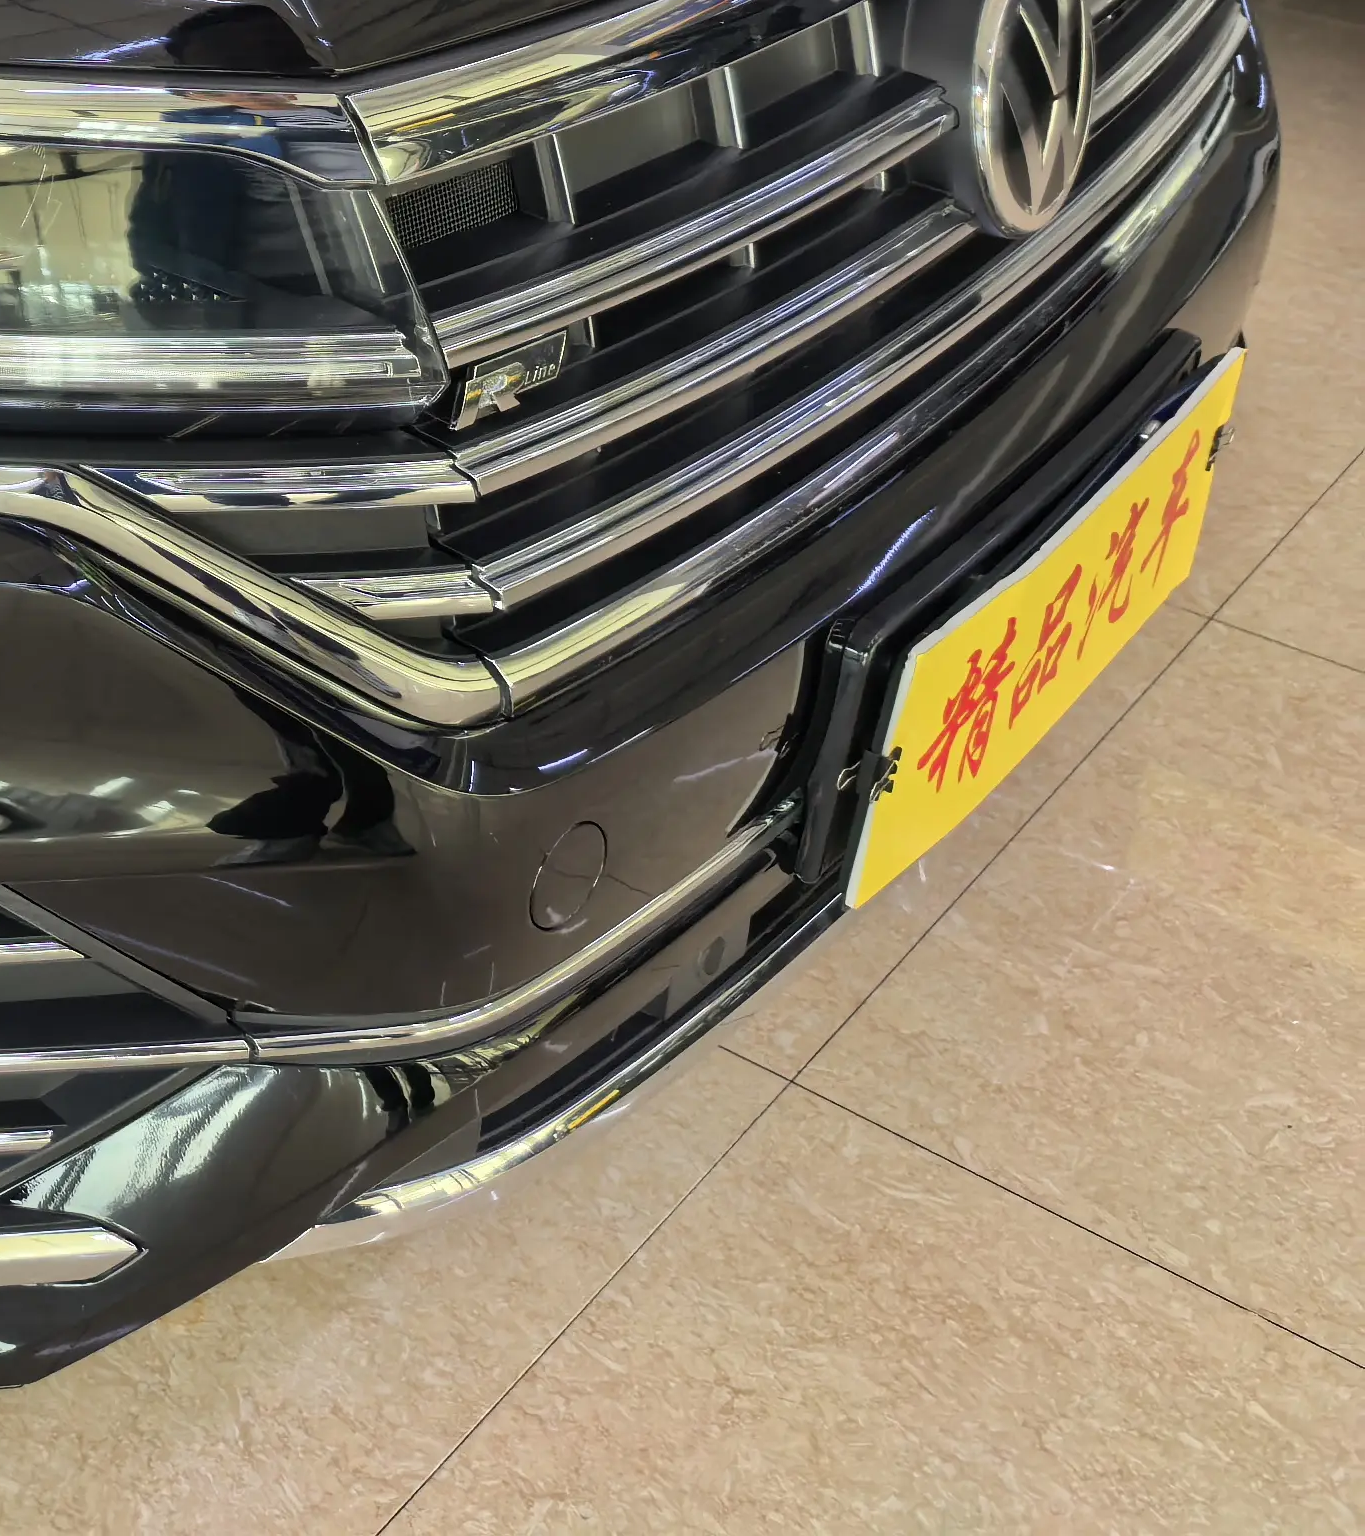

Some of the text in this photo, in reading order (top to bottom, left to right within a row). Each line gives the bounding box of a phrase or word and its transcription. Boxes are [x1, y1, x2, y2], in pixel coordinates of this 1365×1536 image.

[523, 362, 557, 386] Line
[916, 429, 1200, 794] 精品汽车
